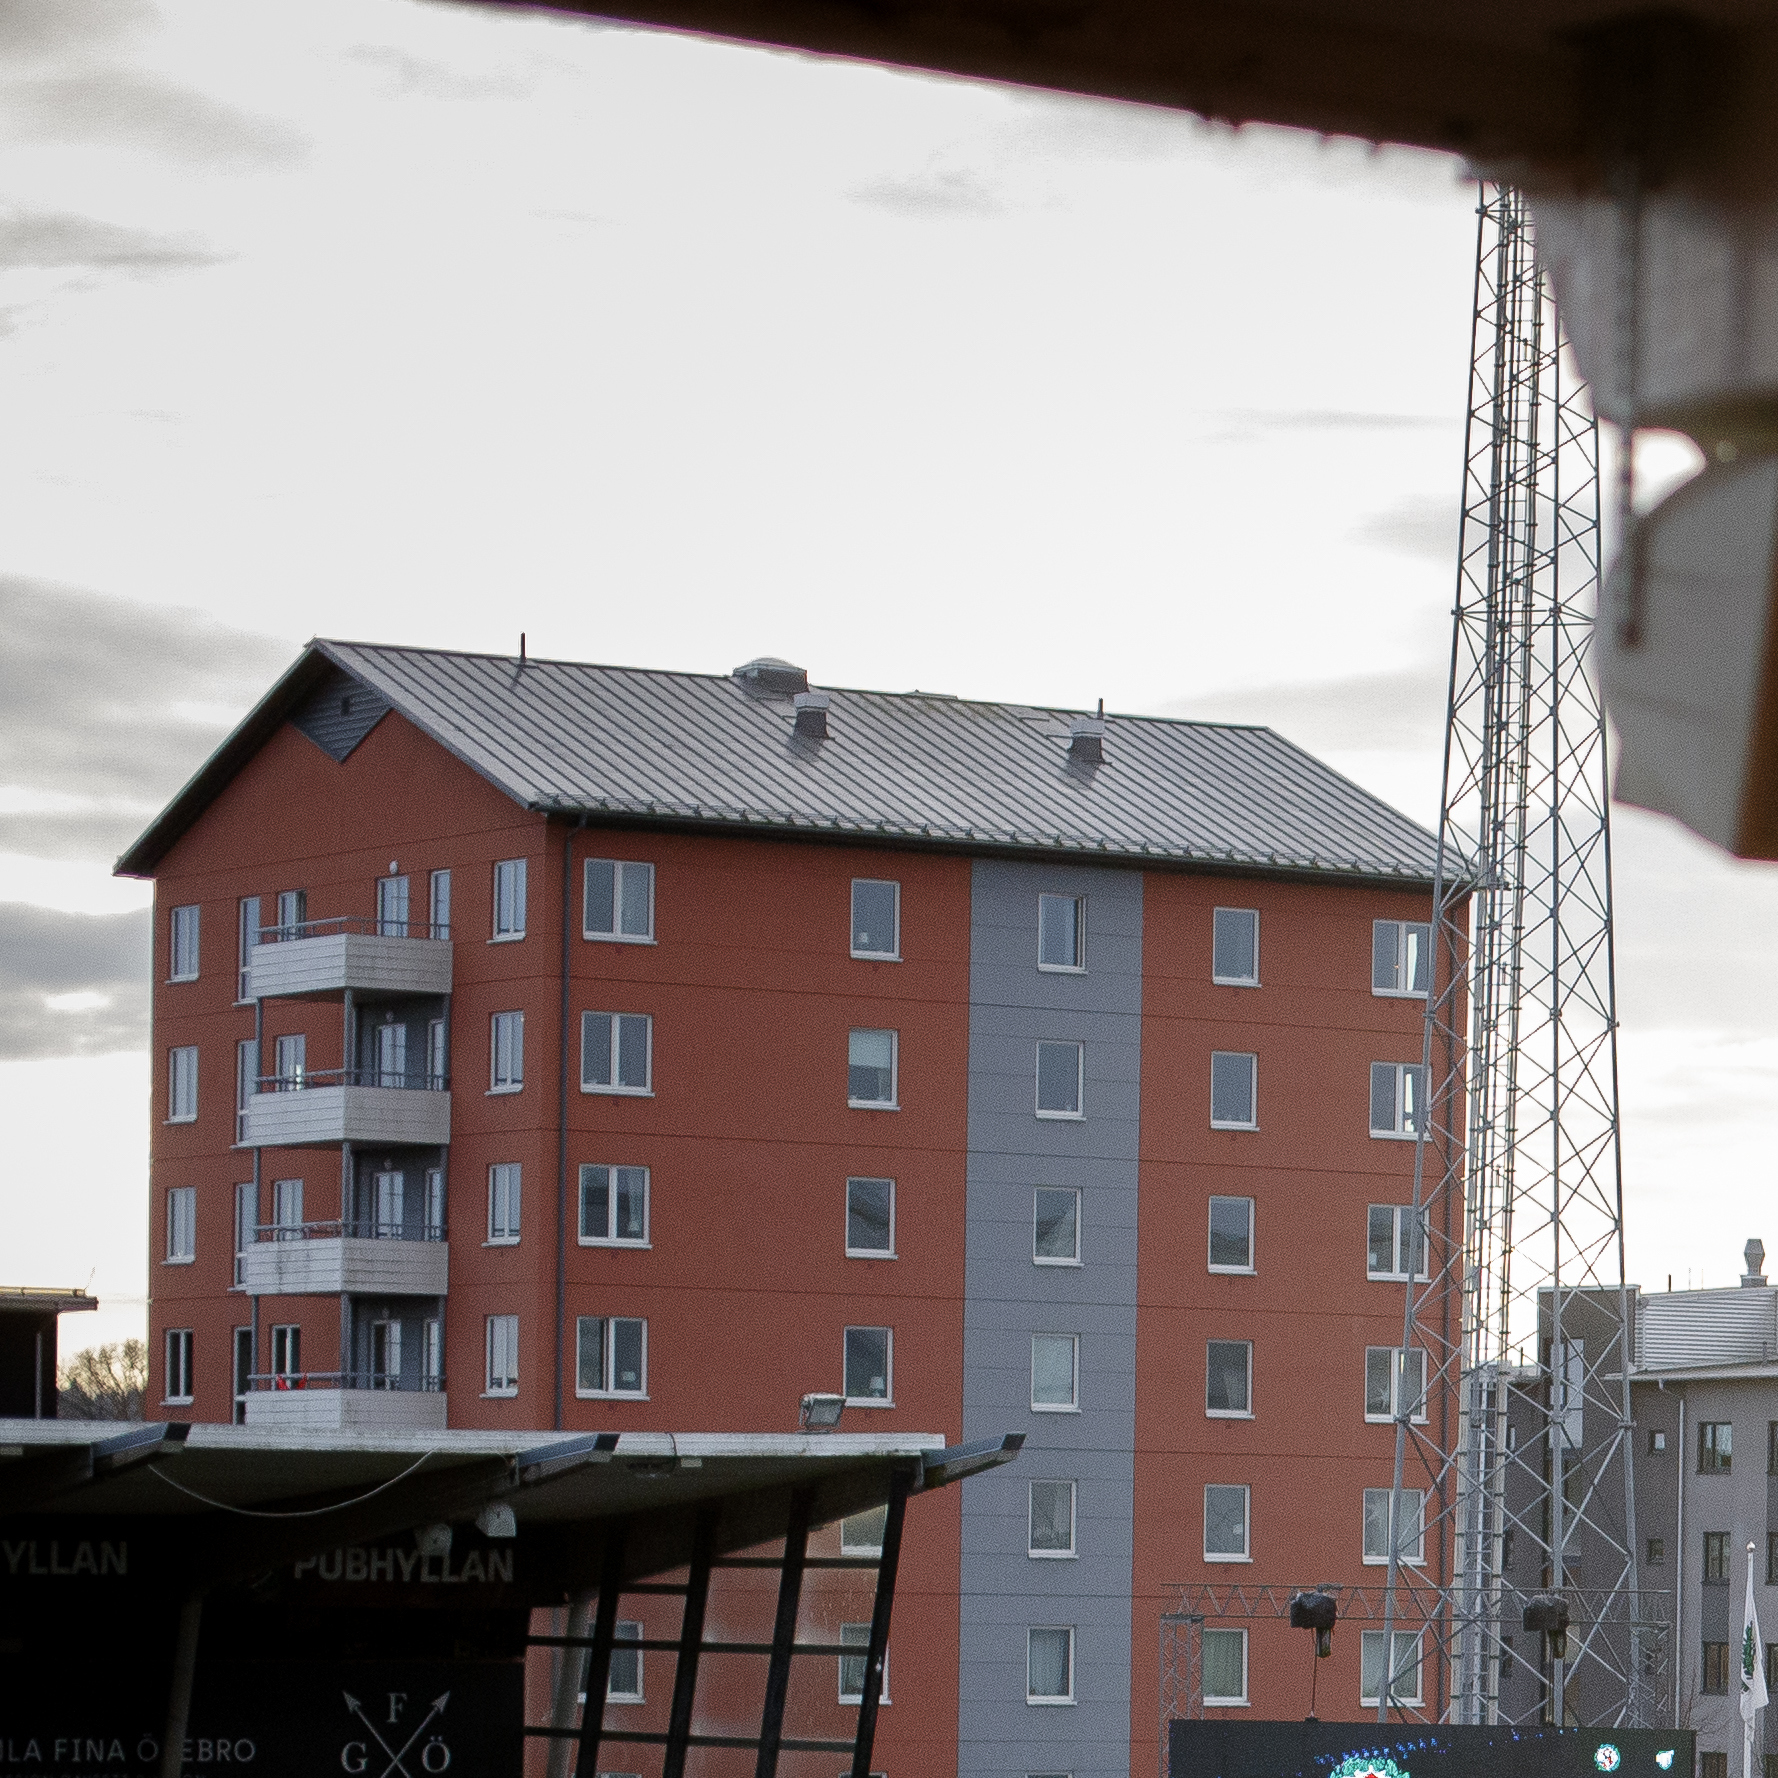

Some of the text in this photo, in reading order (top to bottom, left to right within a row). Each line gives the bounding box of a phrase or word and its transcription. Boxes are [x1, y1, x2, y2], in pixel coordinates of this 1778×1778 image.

[294, 1548, 514, 1583] PUBHYLLAN
[386, 1692, 408, 1723] F
[0, 1733, 257, 1763] LA FINA ÖEBRO
[340, 1735, 452, 1774] G Ö
